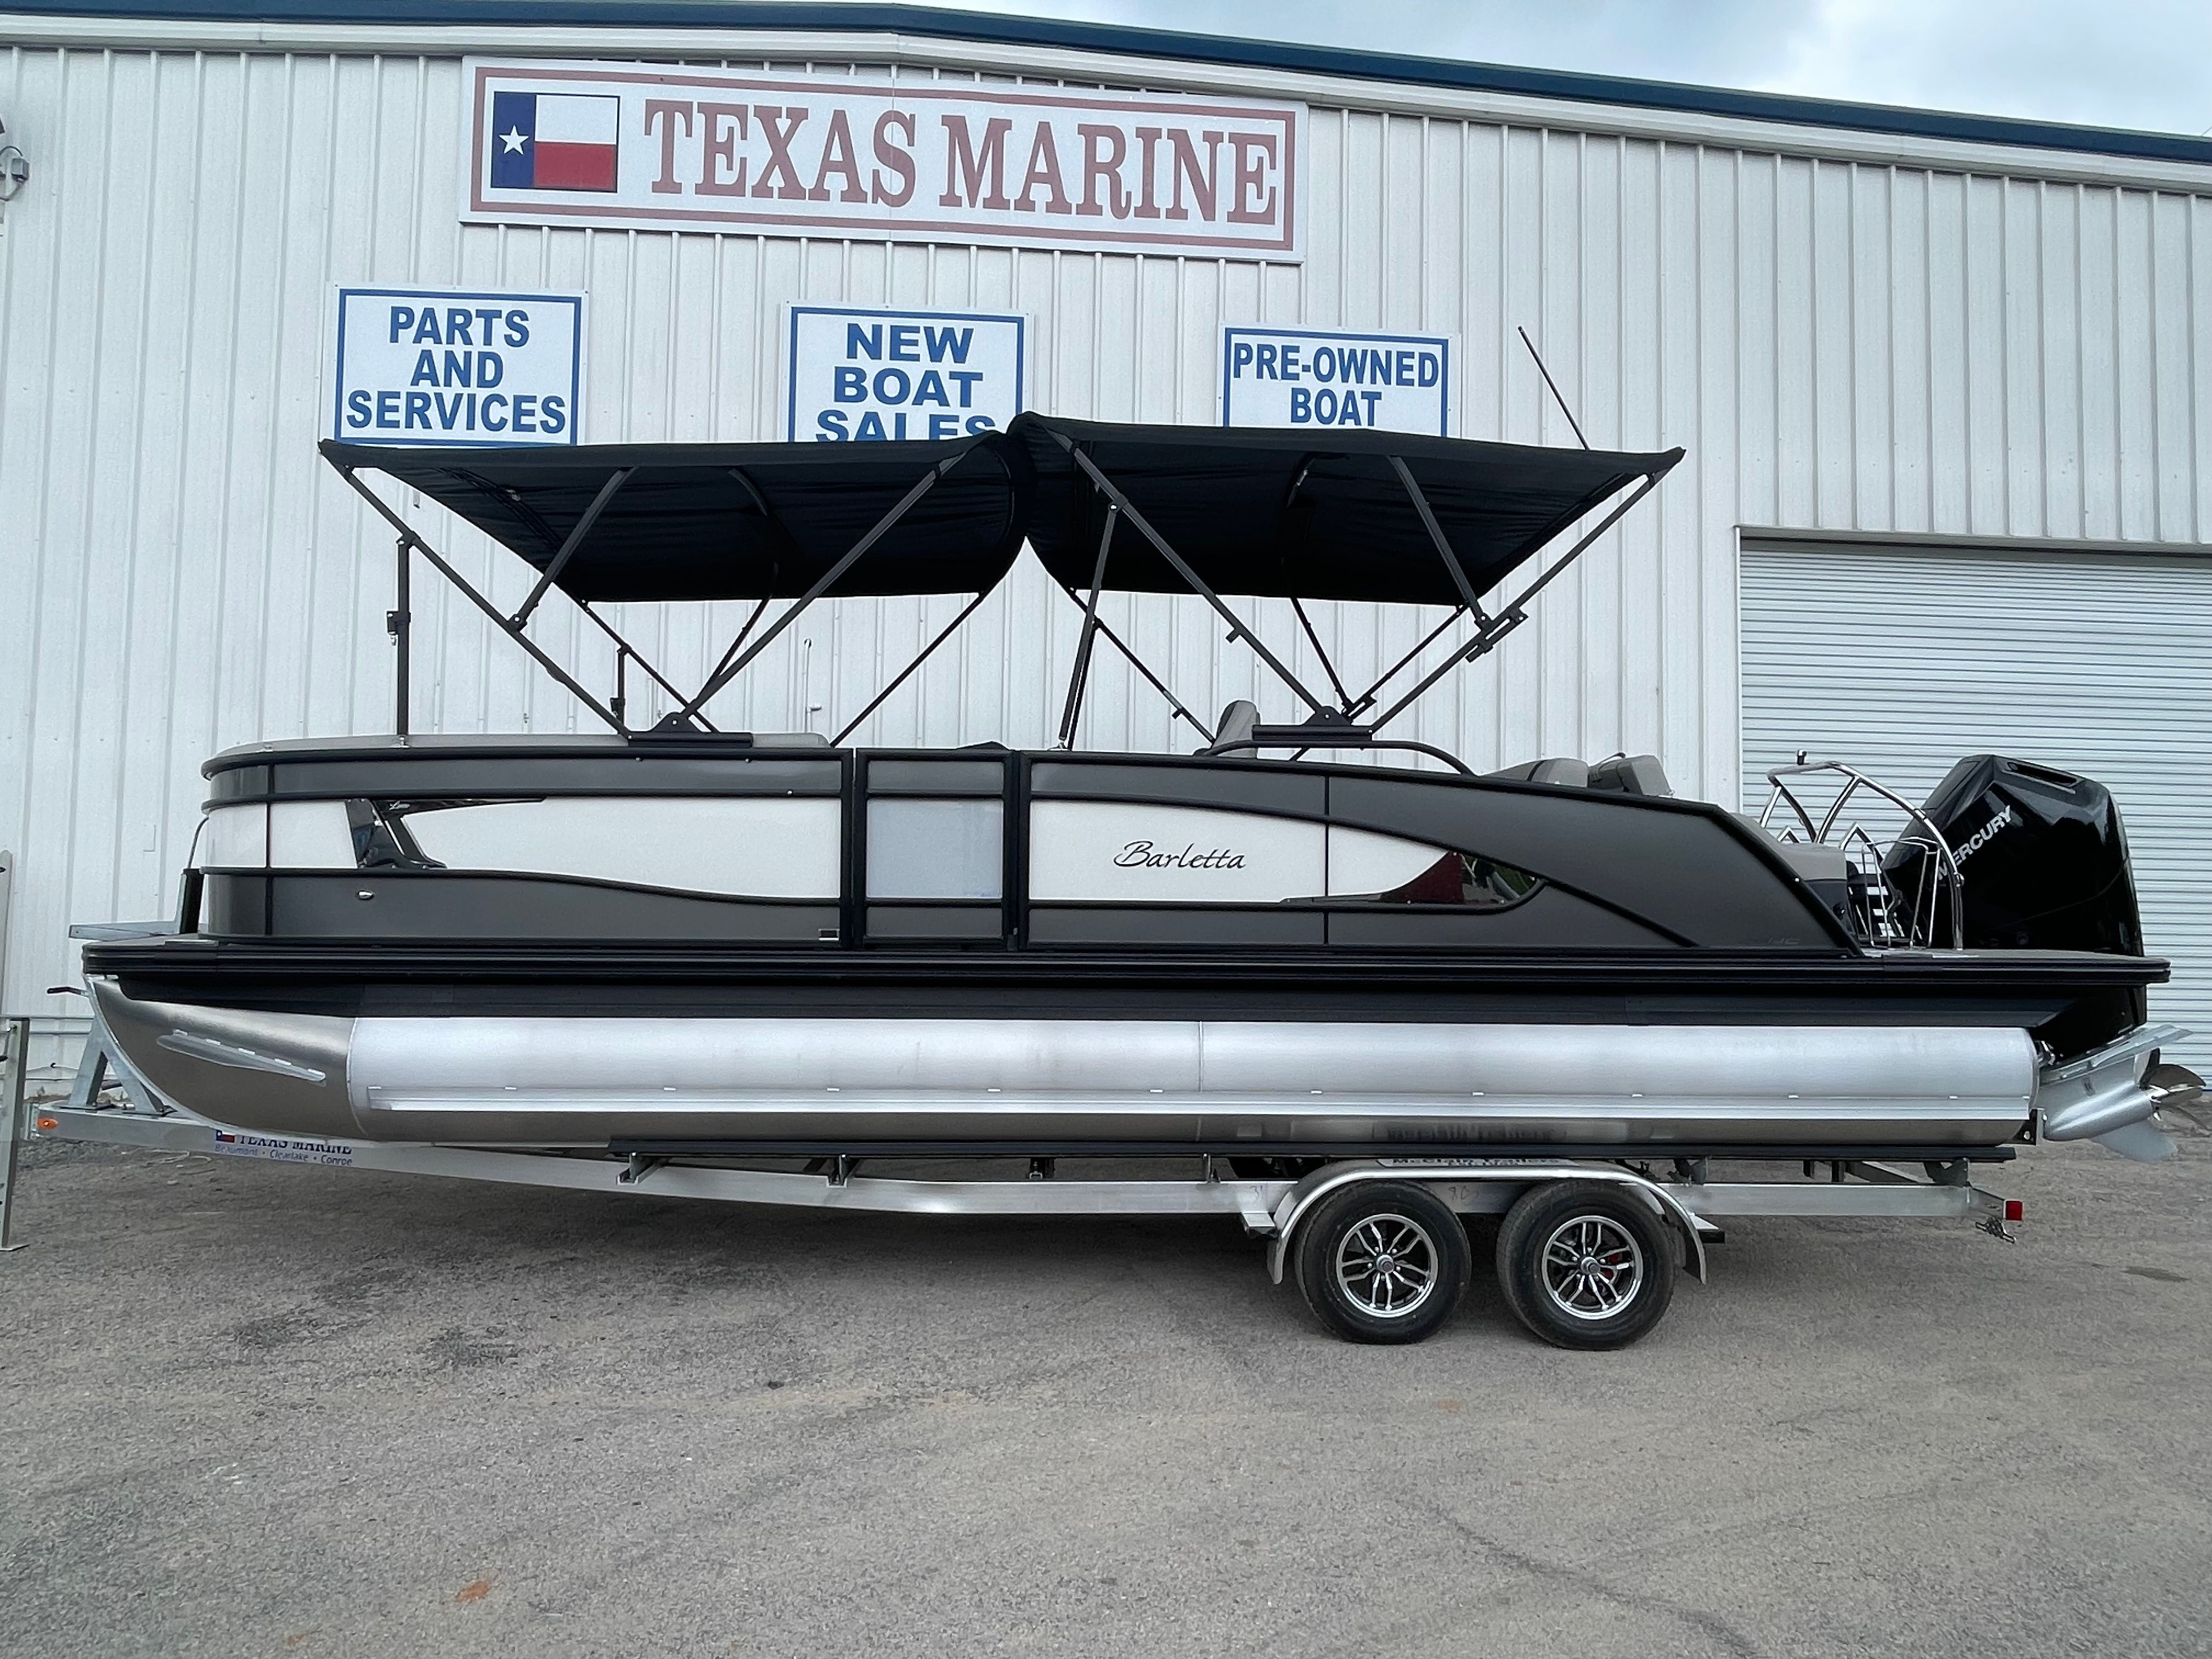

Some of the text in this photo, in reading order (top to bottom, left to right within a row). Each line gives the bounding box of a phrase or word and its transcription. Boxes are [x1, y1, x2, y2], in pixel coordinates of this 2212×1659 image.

[645, 99, 1277, 225] TEXAS MARINE
[389, 306, 530, 347] PARTS
[847, 323, 974, 364] NEW
[410, 349, 504, 388] AND
[1233, 342, 1440, 387] PRE-OWNED
[833, 366, 984, 408] BOAT
[1290, 387, 1383, 427] BOAT
[346, 390, 566, 434] SERVICES
[1113, 840, 1246, 869] Barletta
[269, 1149, 309, 1162] Clearlake
[320, 1154, 352, 1166] Conroe
